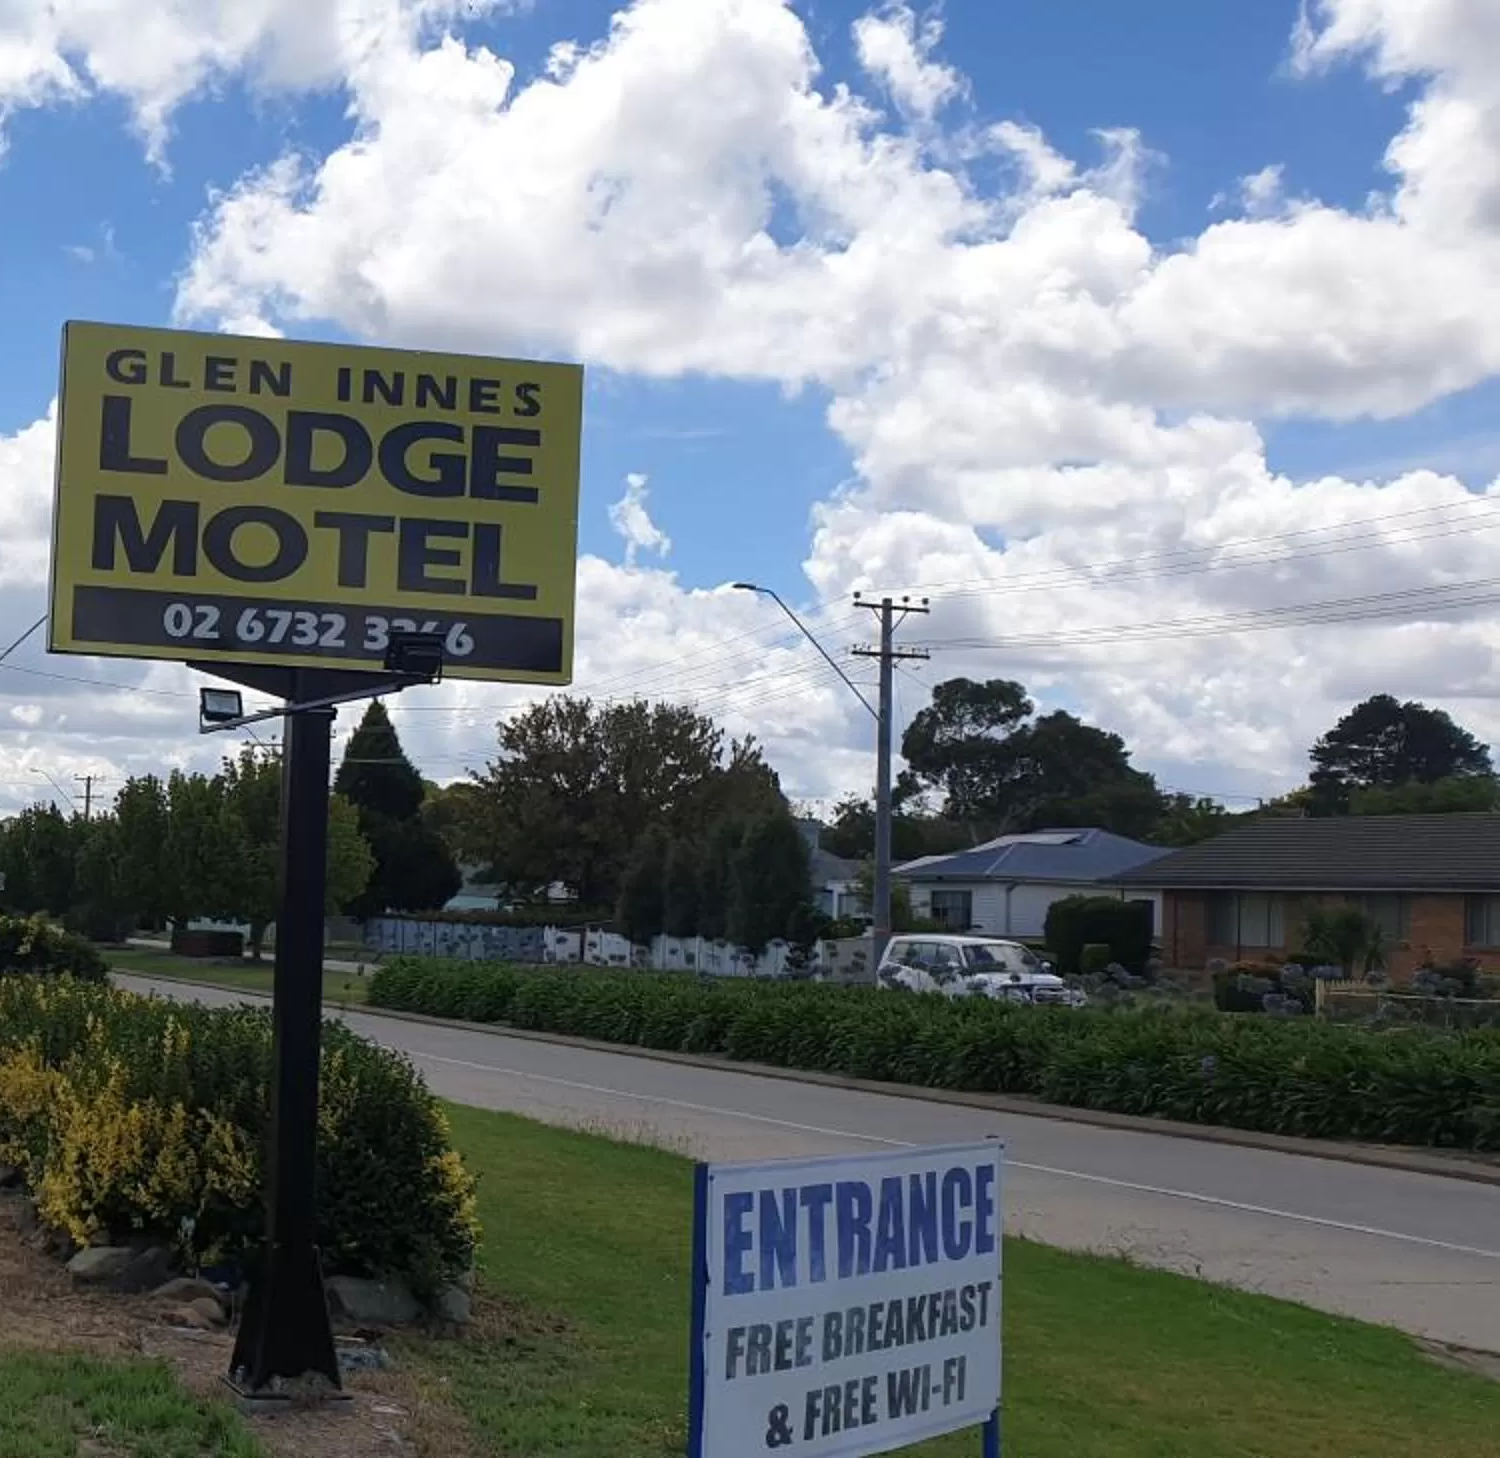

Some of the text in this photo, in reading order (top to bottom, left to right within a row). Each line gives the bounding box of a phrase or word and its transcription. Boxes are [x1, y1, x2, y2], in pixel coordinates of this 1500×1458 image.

[105, 348, 541, 417] GLEN INNES
[99, 395, 541, 504] LODGE
[91, 493, 538, 600] MOTEL
[163, 602, 220, 640] 02
[236, 605, 347, 649] 6732
[722, 1164, 995, 1296] ENTRANCE
[725, 1280, 993, 1381] FREE BREAKFAST
[765, 1355, 967, 1449] & FREE WI-FI
